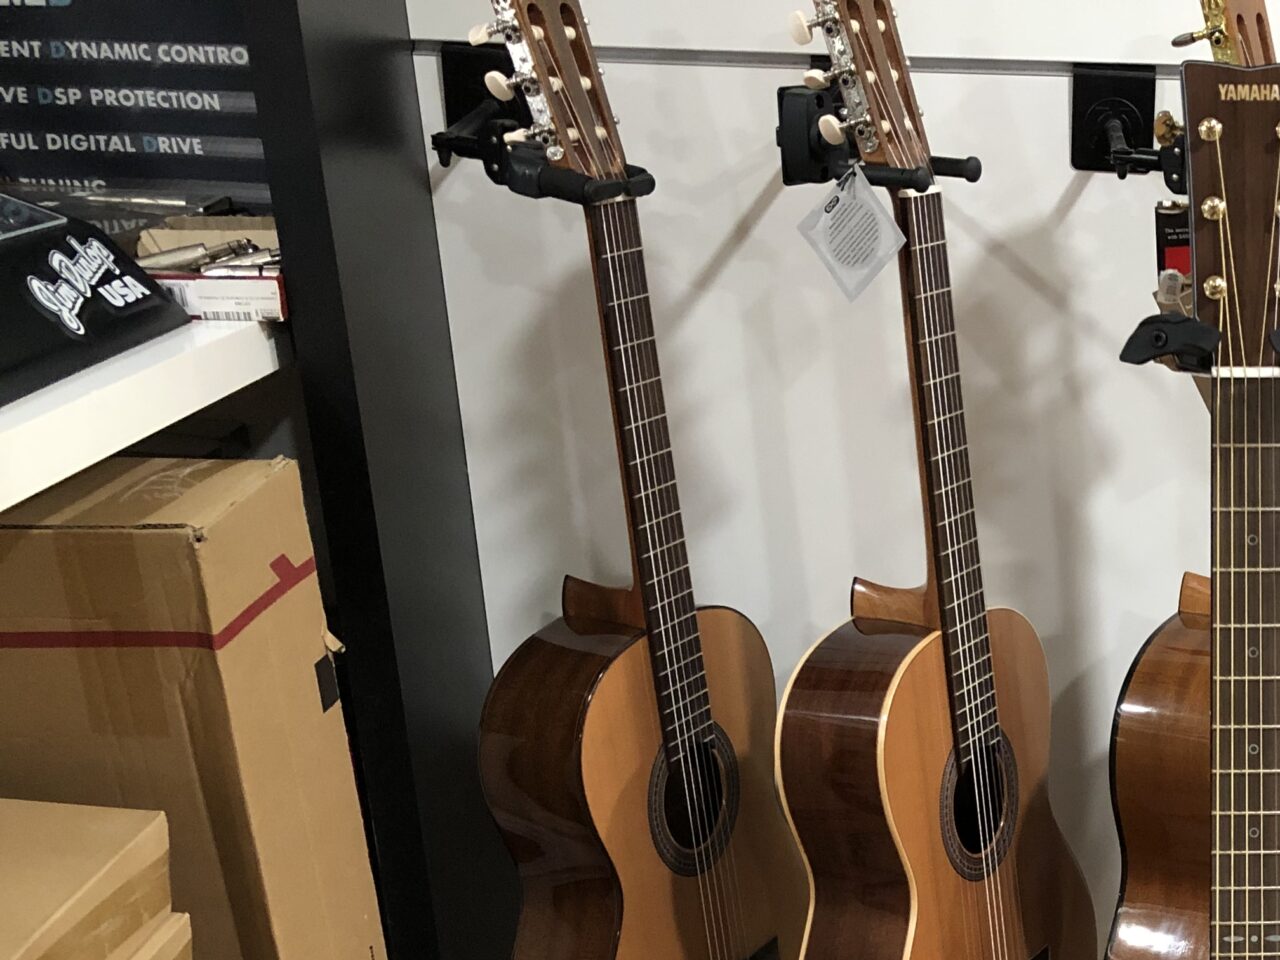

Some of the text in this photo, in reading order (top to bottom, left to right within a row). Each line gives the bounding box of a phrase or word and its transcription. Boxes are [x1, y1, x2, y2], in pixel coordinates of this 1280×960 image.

[0, 41, 41, 58] ENT
[50, 42, 151, 61] DYNAMIC
[37, 87, 81, 106] DSP
[90, 88, 220, 112] PROTECTION
[1218, 83, 1280, 101] YAMAHA
[46, 133, 136, 153] DIGITAL
[143, 135, 204, 155] DRIVE
[27, 235, 120, 335] Jim Dunlop
[97, 275, 151, 307] USA
